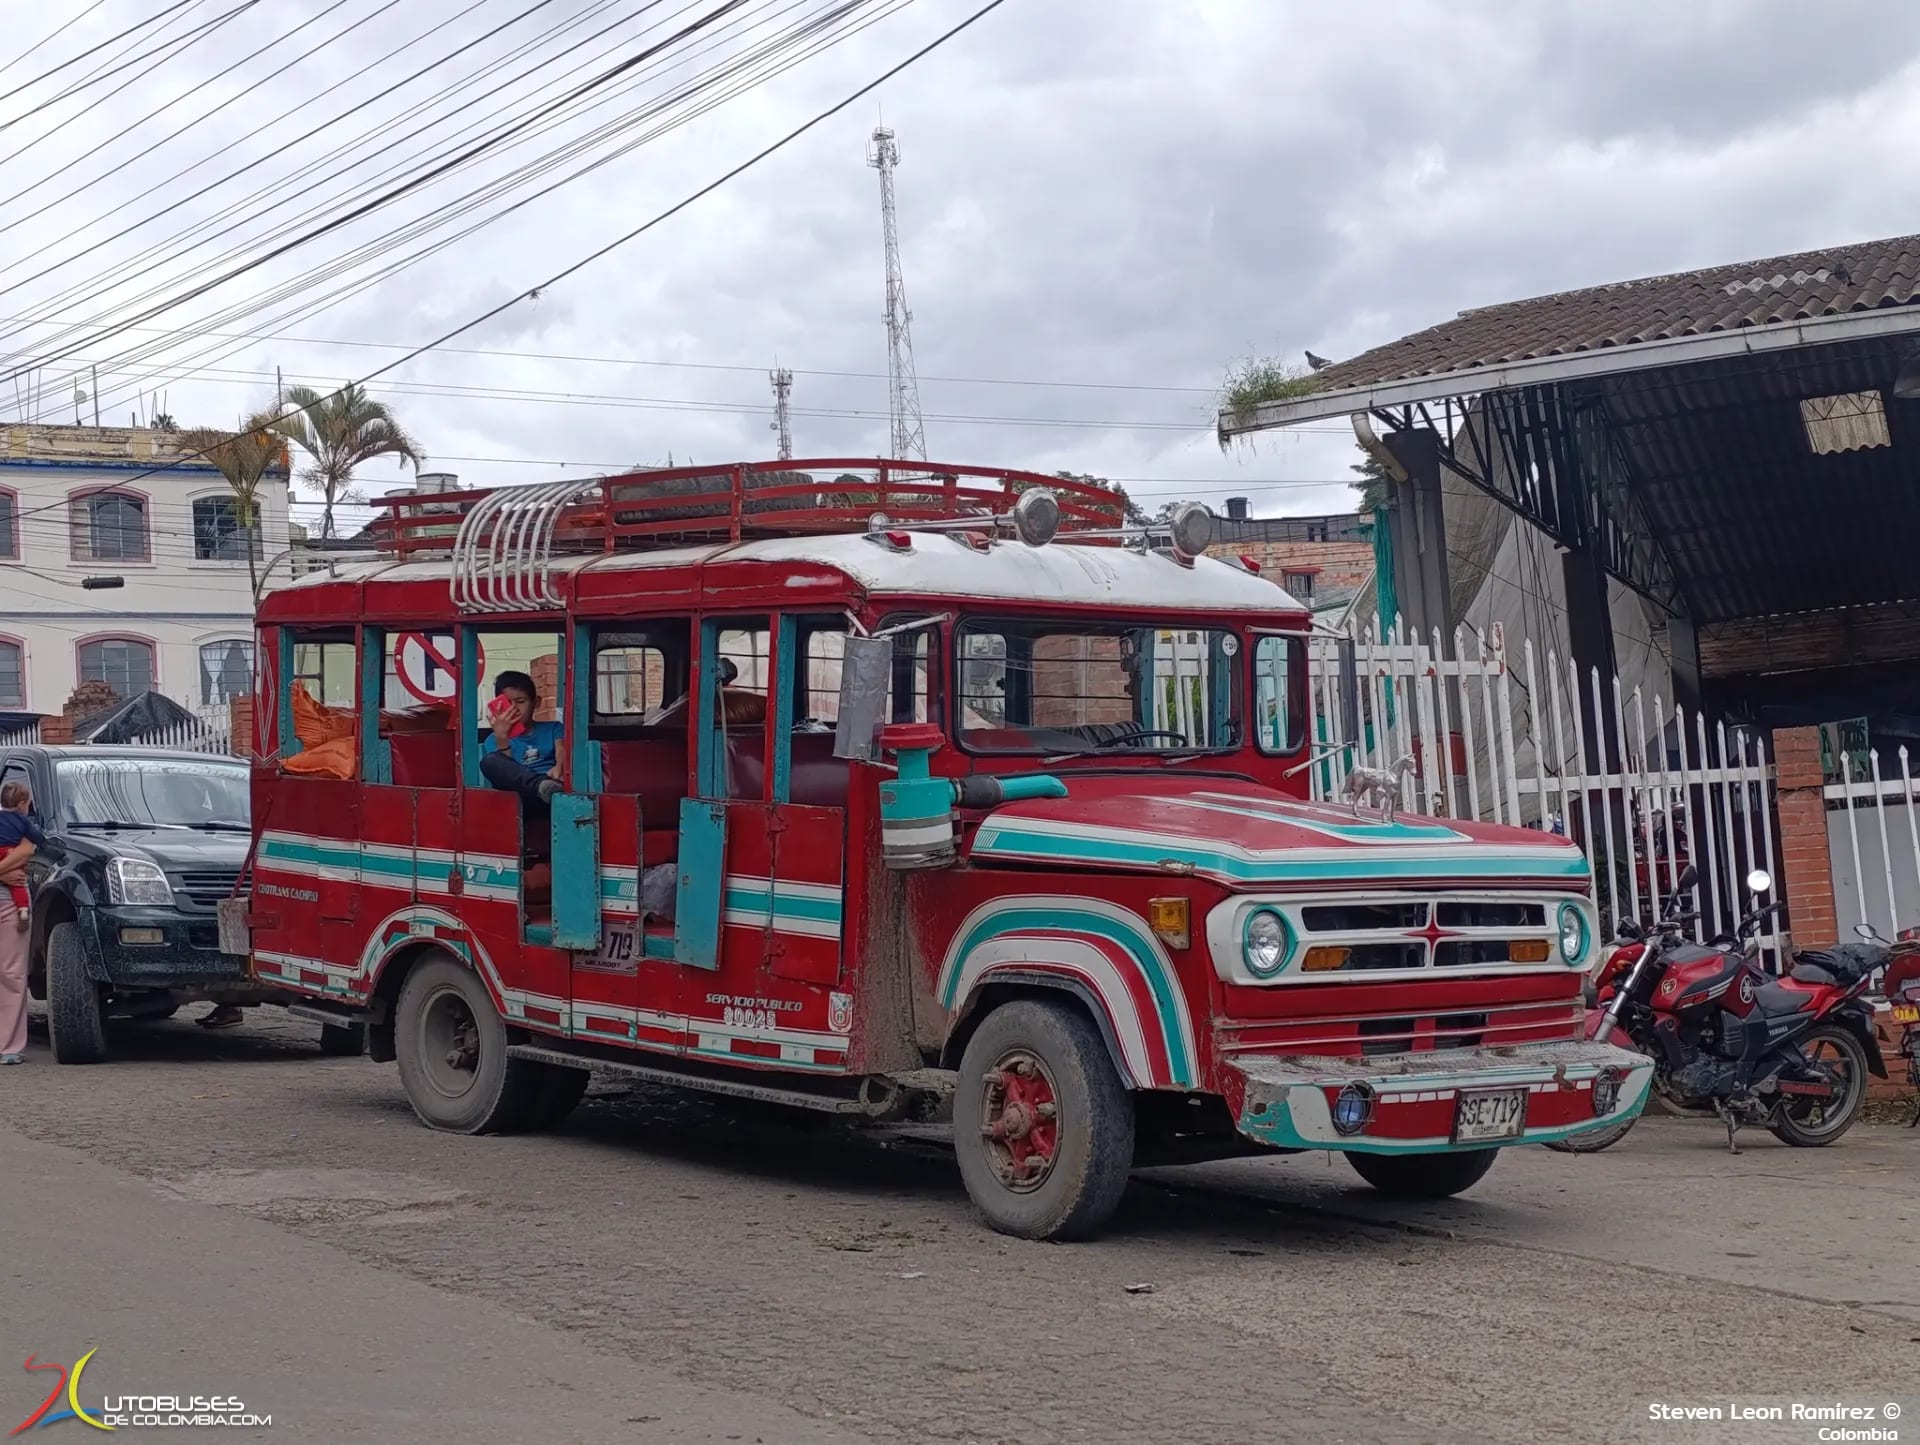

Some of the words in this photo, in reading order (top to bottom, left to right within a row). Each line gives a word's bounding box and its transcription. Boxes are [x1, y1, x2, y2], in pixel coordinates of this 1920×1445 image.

[705, 993, 755, 1007] SERVICIO
[755, 998, 803, 1012] PUBLICO
[1768, 1025, 1789, 1036] YAMAHA
